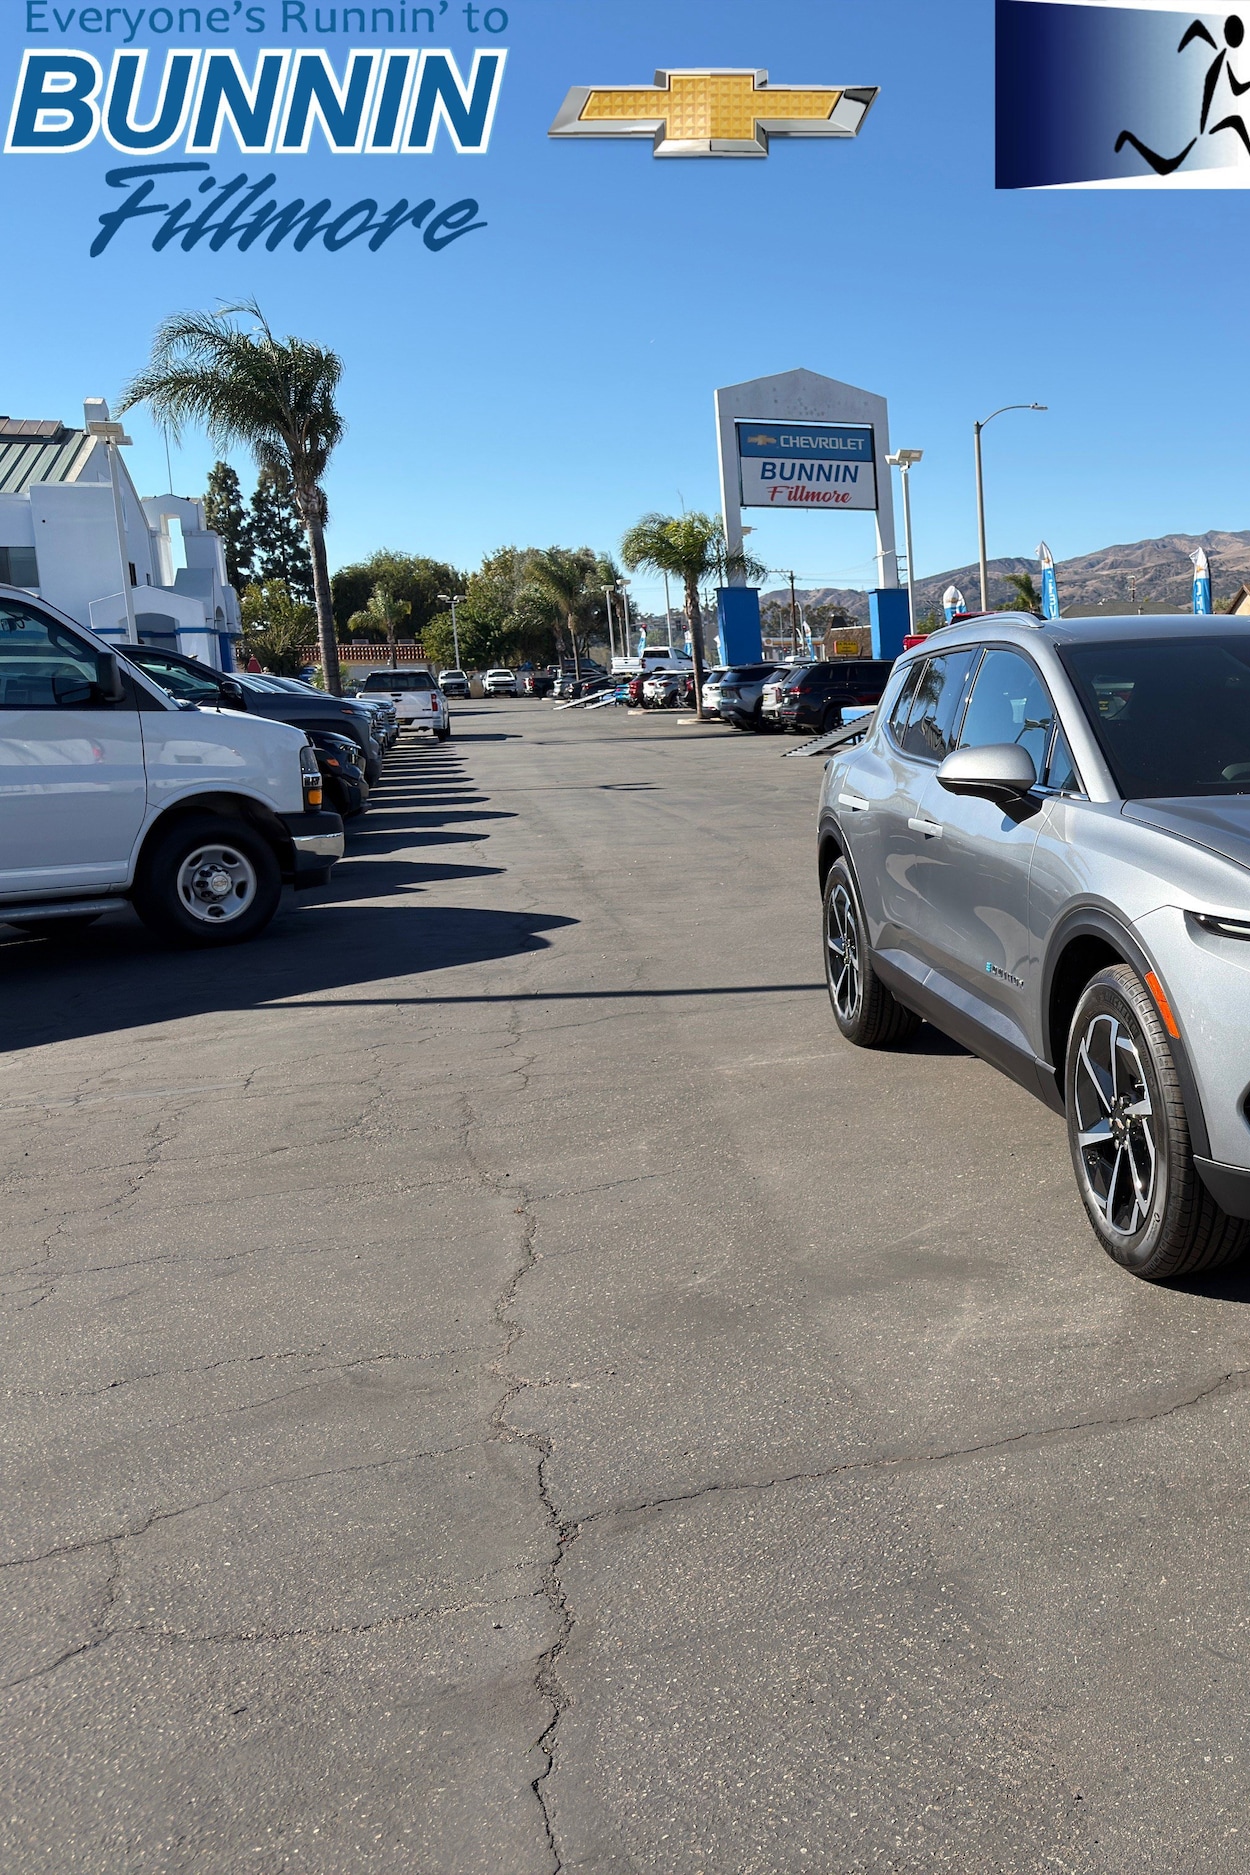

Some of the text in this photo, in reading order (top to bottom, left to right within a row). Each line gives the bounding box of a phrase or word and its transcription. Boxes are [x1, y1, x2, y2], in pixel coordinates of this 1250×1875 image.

[779, 435, 865, 451] CHEVROLET
[760, 461, 859, 483] BUNNIN
[766, 485, 853, 504] Fillmore
